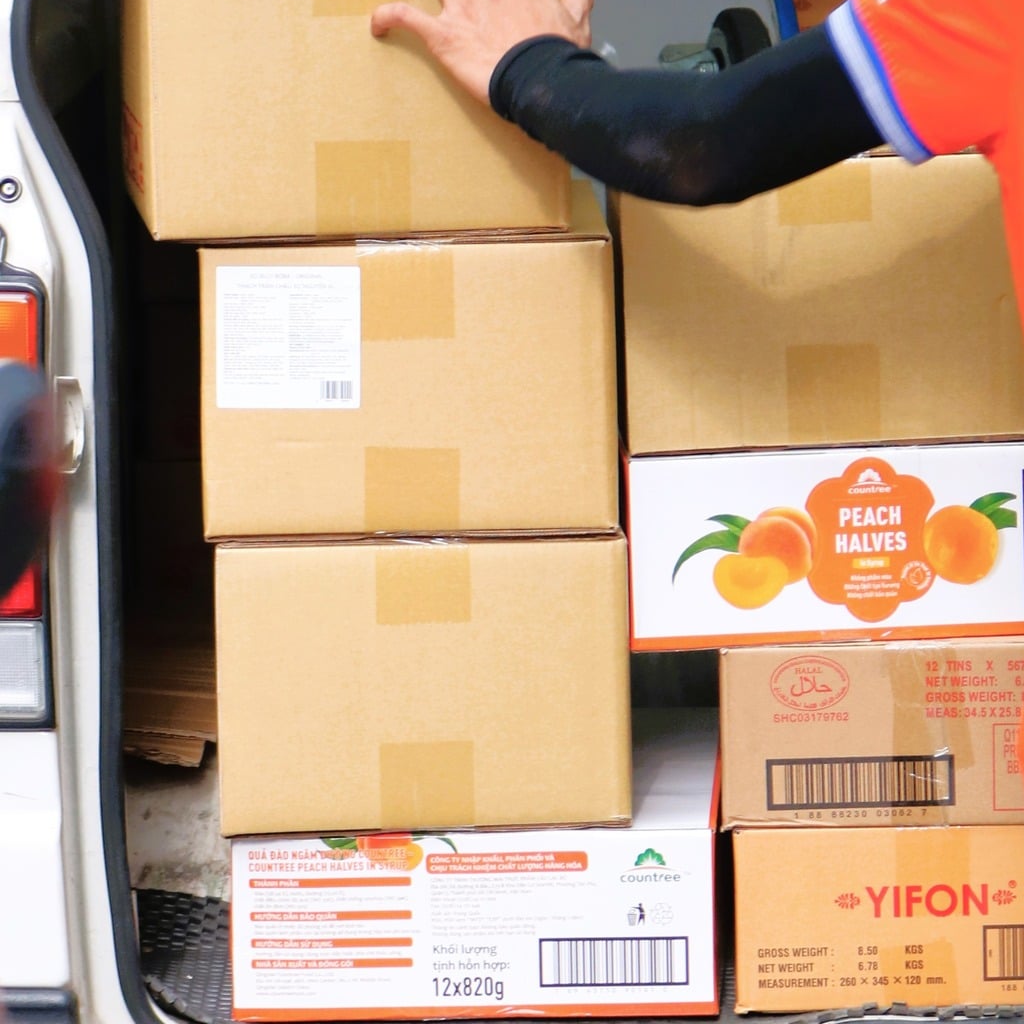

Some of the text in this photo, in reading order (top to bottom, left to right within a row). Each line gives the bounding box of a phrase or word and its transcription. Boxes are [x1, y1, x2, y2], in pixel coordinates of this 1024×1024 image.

[847, 484, 892, 495] countree
[839, 505, 902, 528] PEACH
[834, 531, 908, 554] HALVES
[925, 660, 939, 672] 12
[946, 660, 973, 672] TINS
[790, 675, 833, 697] حلال
[925, 676, 947, 687] NET
[950, 675, 998, 687] WEIGHT:
[925, 692, 966, 703] GROSS
[968, 691, 1017, 702] WEIGHT:
[925, 707, 962, 718] MEAS:
[964, 707, 987, 717] 34.5
[248, 860, 409, 872] COUNTREE PEACH HALVES IN SYRUP
[620, 872, 682, 883] countree
[865, 883, 989, 918] YIFON
[433, 944, 497, 957] Khối lượng
[758, 947, 790, 958] GROSS
[792, 946, 828, 957] WEIGHT
[905, 944, 924, 955] KGS
[433, 960, 455, 973] tịnh
[758, 963, 777, 973] NET
[779, 962, 814, 973] WEIGHT
[905, 959, 924, 970] KGS
[432, 976, 504, 1001] 12x820g
[758, 977, 829, 989] MEASUREMENT
[839, 976, 857, 987] 260
[872, 975, 889, 986] 345
[905, 975, 922, 986] 120
